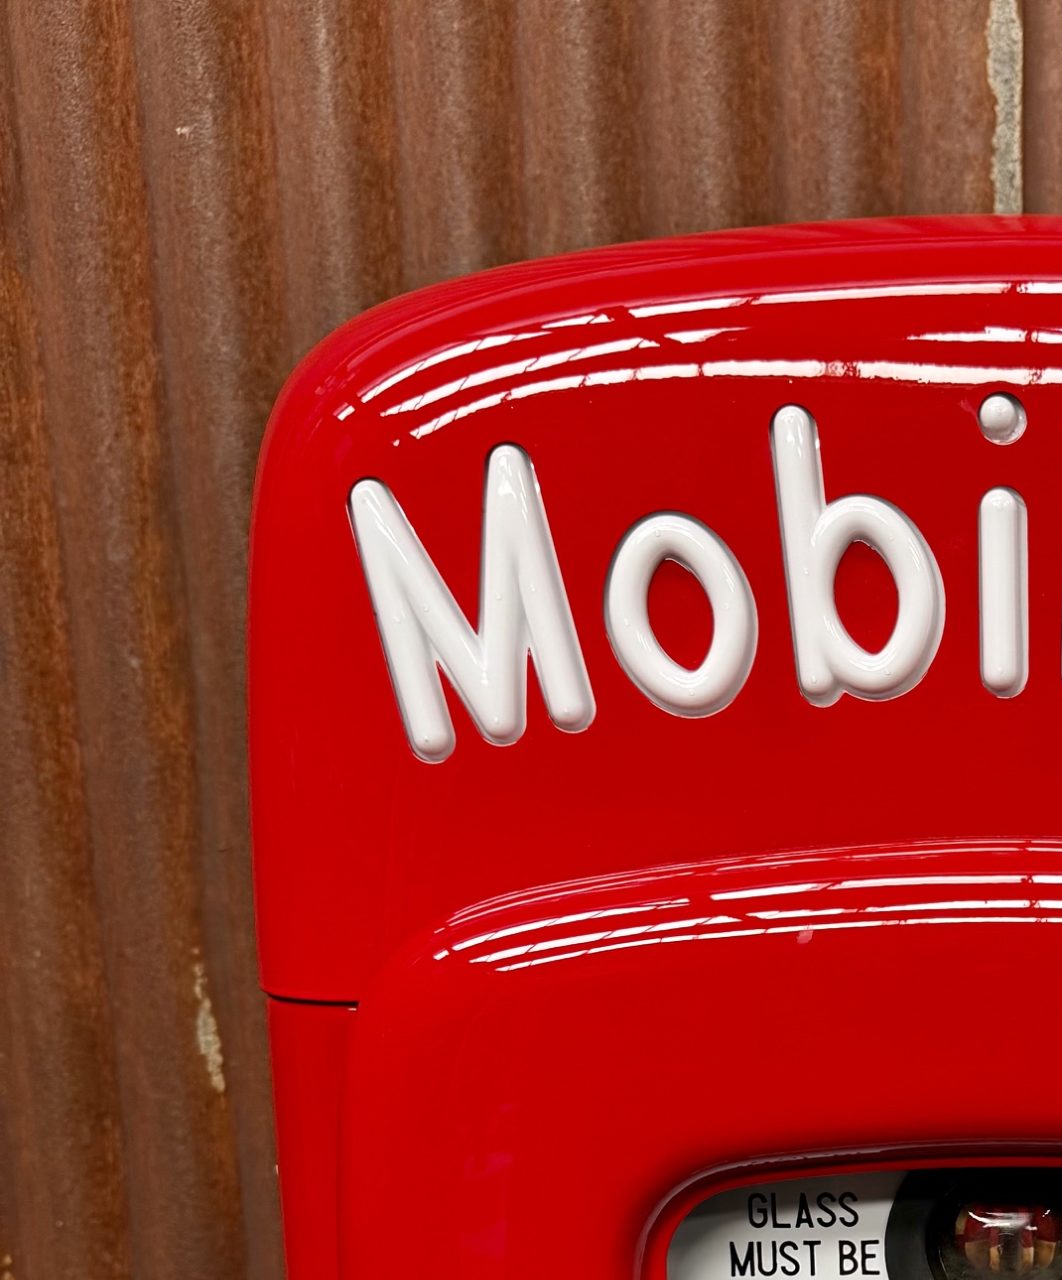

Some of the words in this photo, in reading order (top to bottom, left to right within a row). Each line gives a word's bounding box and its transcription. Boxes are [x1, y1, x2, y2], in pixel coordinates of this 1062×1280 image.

[748, 1191, 859, 1228] GLASS
[729, 1240, 821, 1276] MUST
[839, 1240, 880, 1275] BE
